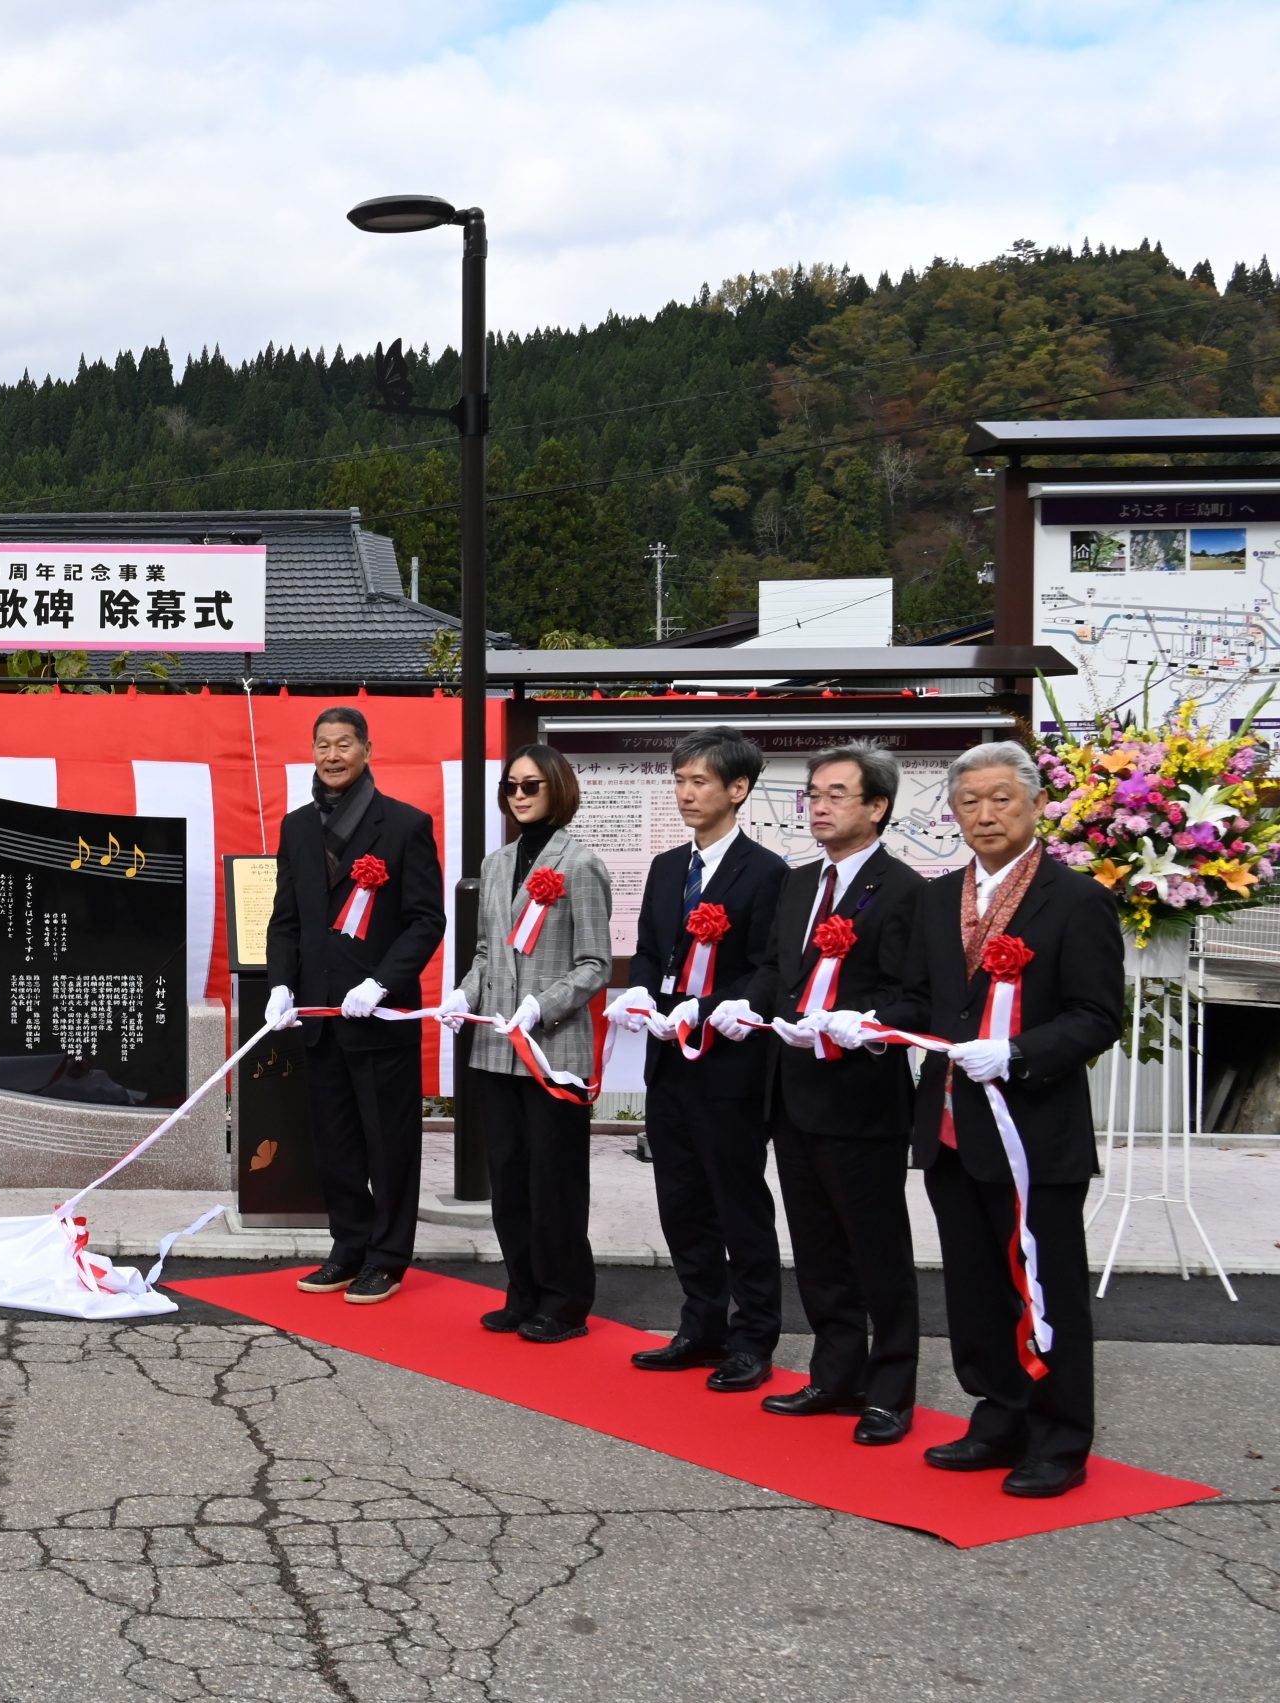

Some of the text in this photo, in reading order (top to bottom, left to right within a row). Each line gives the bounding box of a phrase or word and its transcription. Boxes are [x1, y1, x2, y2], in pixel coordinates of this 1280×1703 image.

[99, 590, 234, 631] 除幕式
[902, 759, 953, 769] ゆかりの地
[24, 873, 34, 962] ふるさとはどこですか
